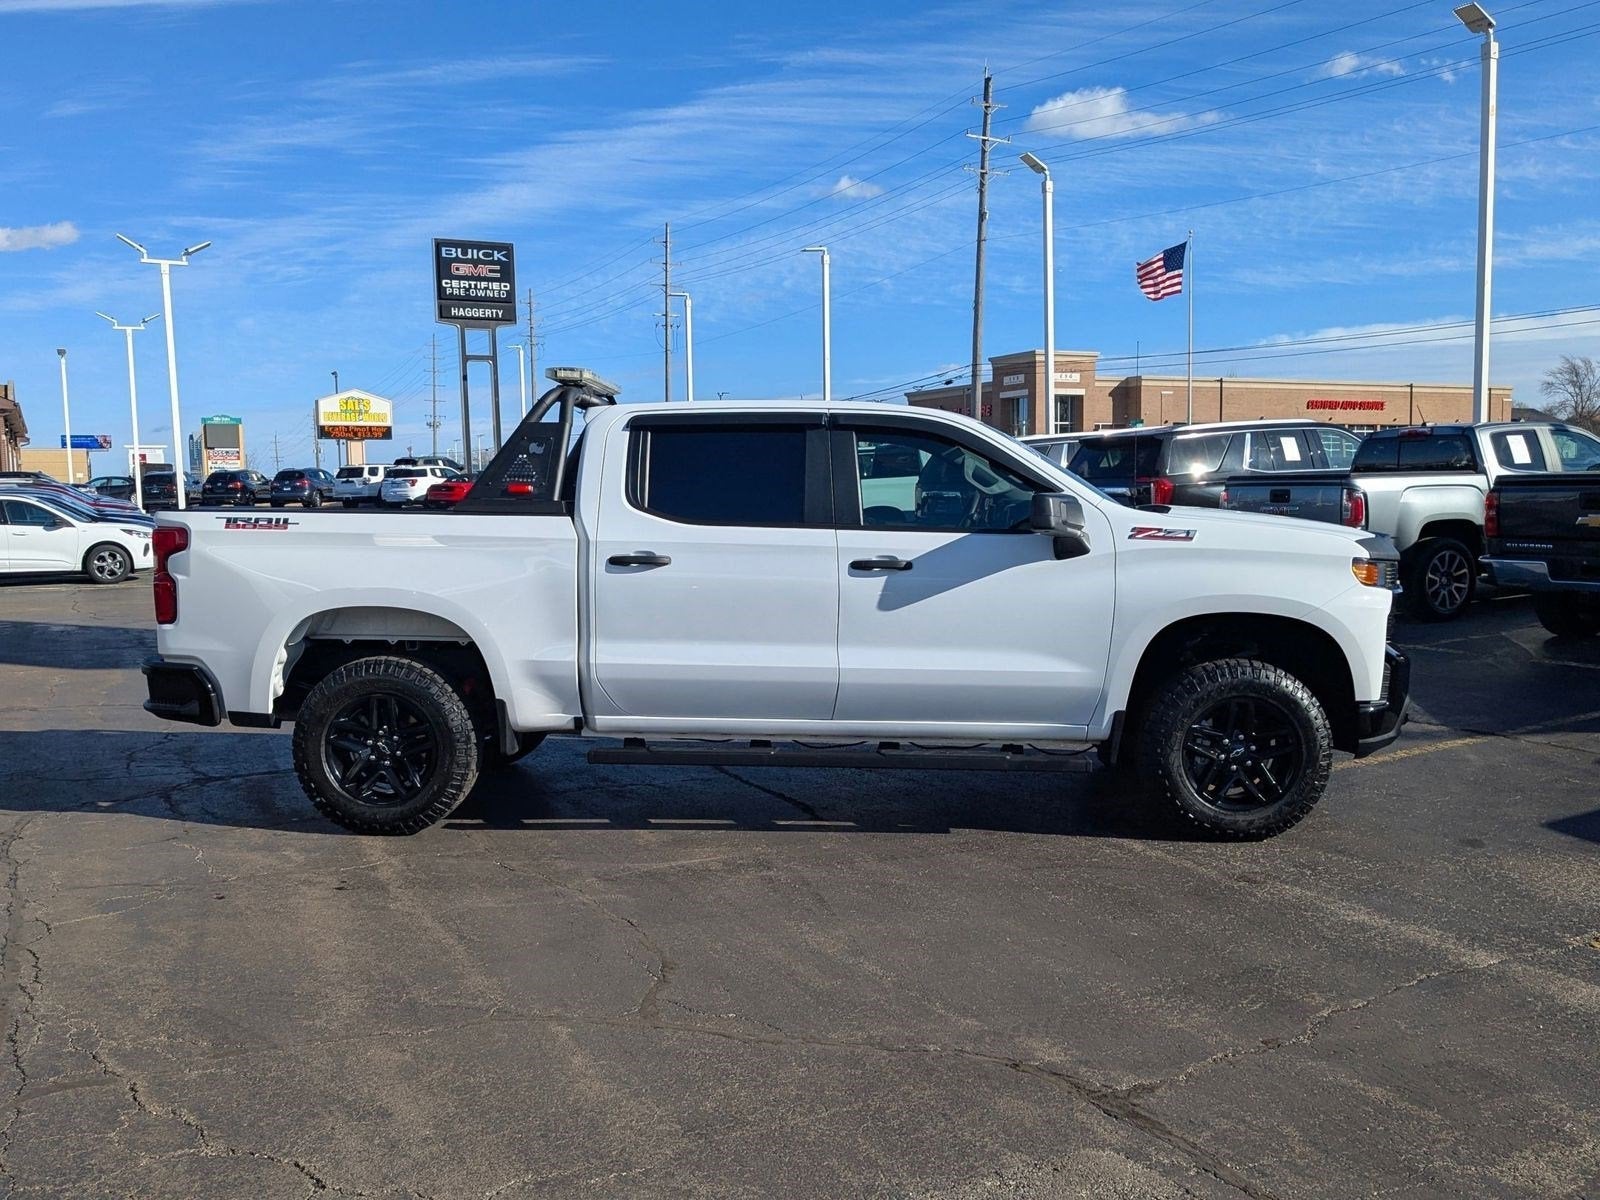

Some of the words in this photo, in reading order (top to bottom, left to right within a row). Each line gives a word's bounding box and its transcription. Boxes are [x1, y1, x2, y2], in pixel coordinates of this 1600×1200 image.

[441, 247, 509, 261] BUICK
[451, 263, 500, 277] GMC
[441, 280, 510, 290] CERTIFIED
[446, 288, 507, 297] PRE-OWNED
[451, 307, 503, 318] HAGGERTY
[1127, 526, 1198, 542] Z71
